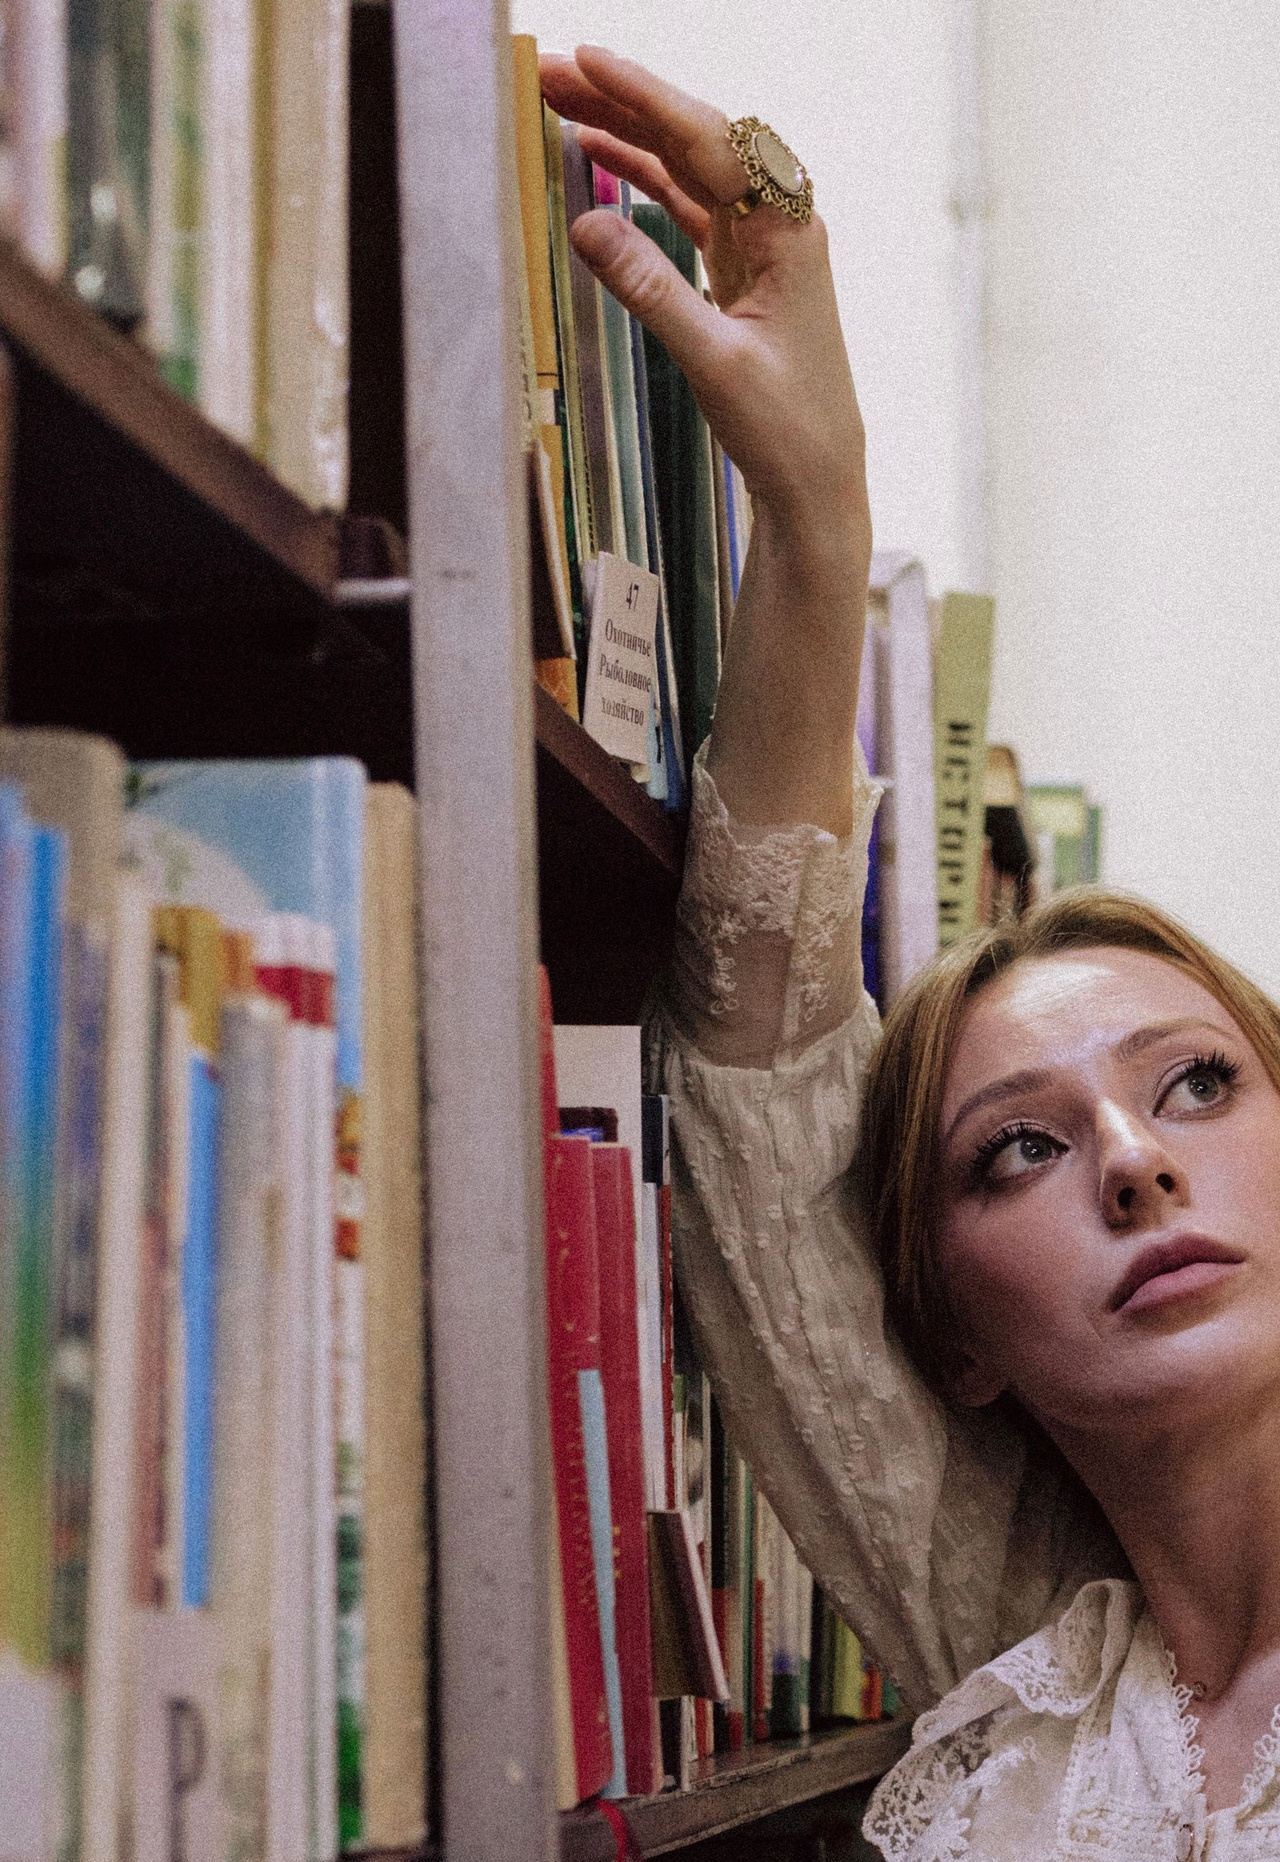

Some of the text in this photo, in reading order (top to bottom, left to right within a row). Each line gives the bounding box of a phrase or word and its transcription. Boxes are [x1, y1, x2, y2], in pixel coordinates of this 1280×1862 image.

[626, 581, 639, 612] 47
[604, 618, 652, 657] Охотничье
[599, 653, 652, 693] Рыболовное
[601, 697, 645, 726] хозяйство
[935, 717, 974, 930] ИСТОРИ
